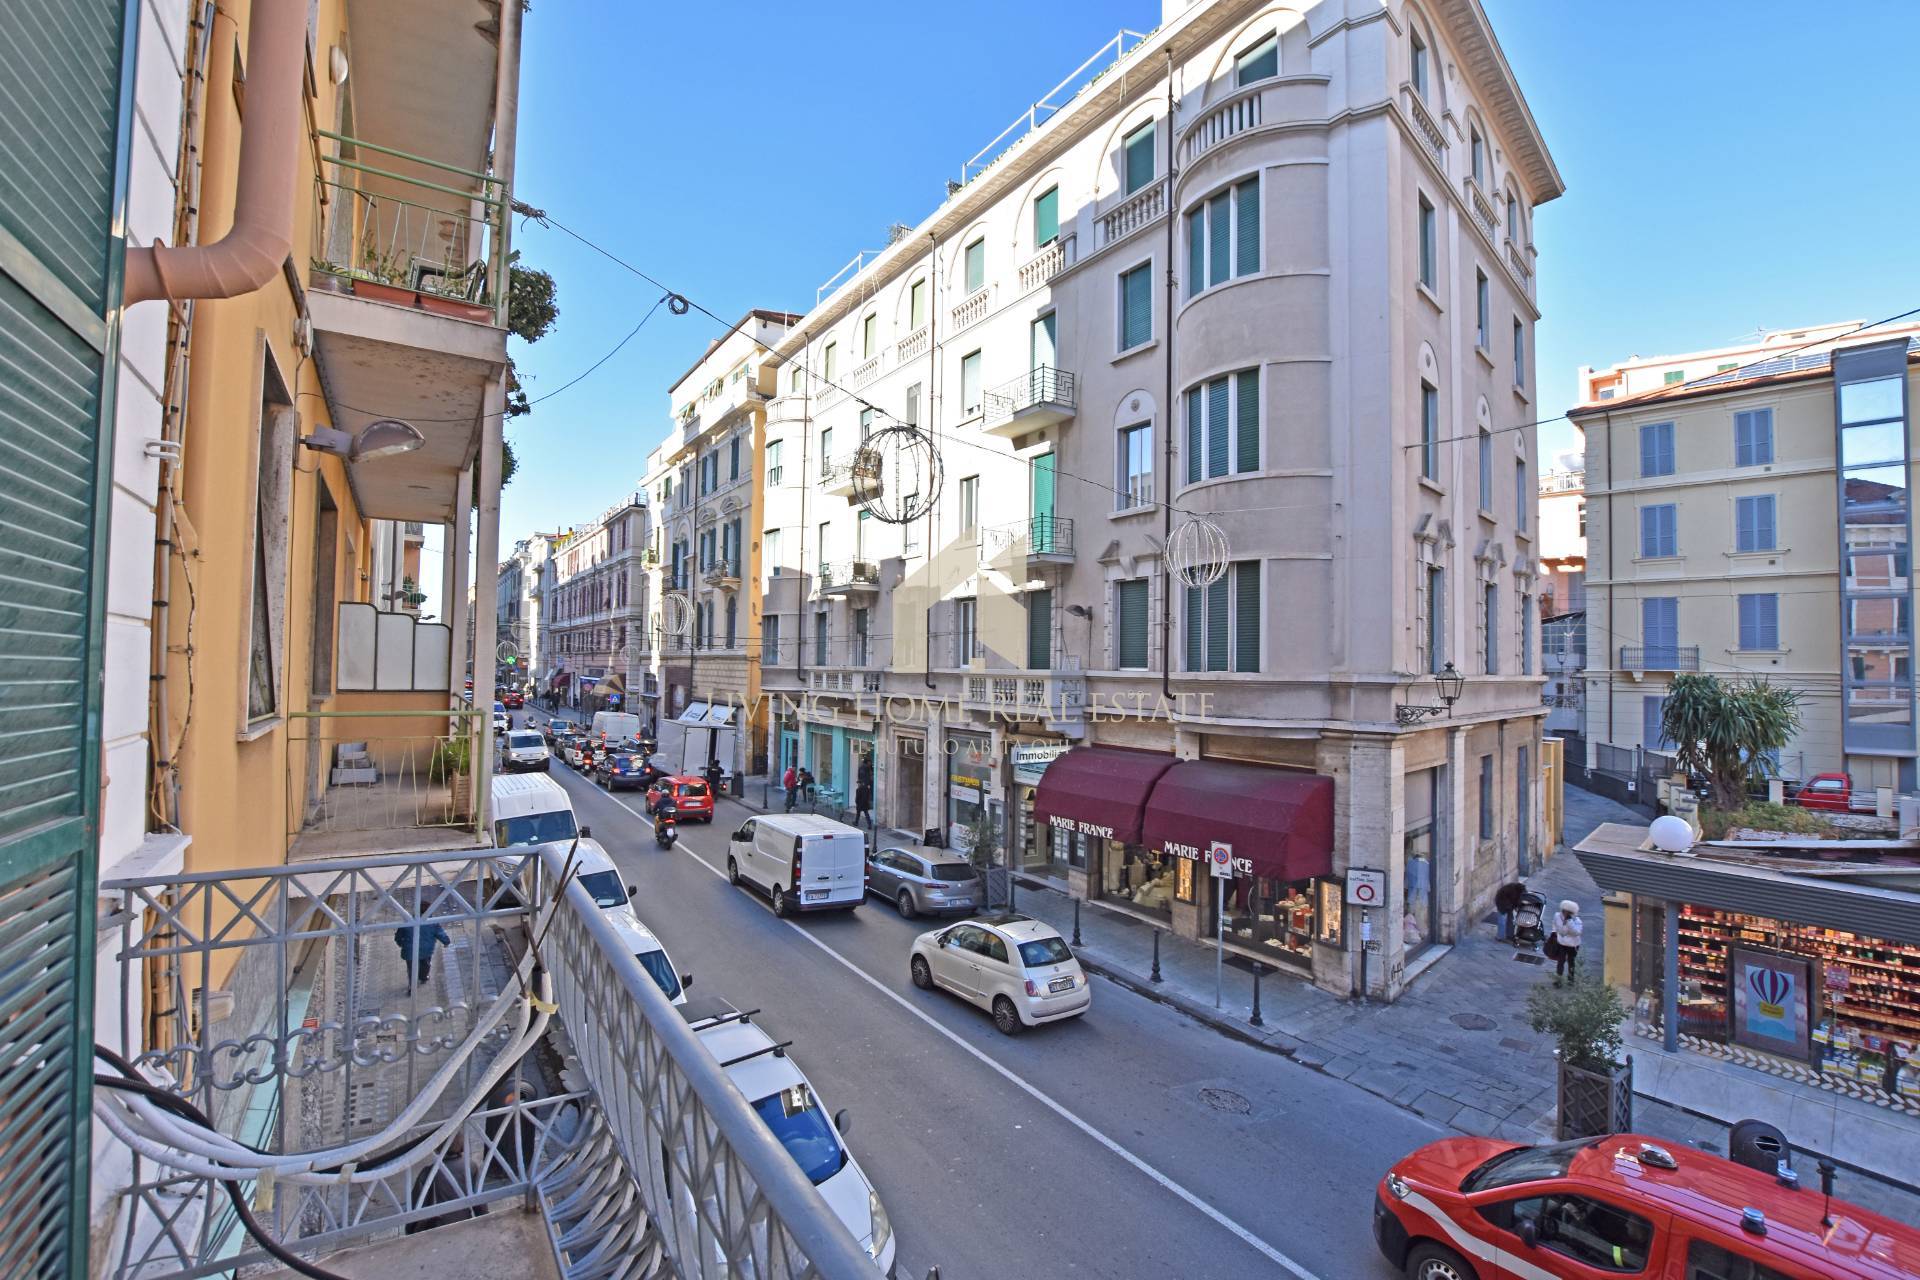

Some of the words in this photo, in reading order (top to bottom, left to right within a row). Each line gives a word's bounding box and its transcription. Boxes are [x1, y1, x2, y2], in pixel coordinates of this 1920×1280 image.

[1049, 815, 1075, 831] MARIE
[1079, 822, 1113, 840] FRANCE
[1164, 840, 1199, 861] MARIE
[1204, 849, 1253, 874] FNCE
